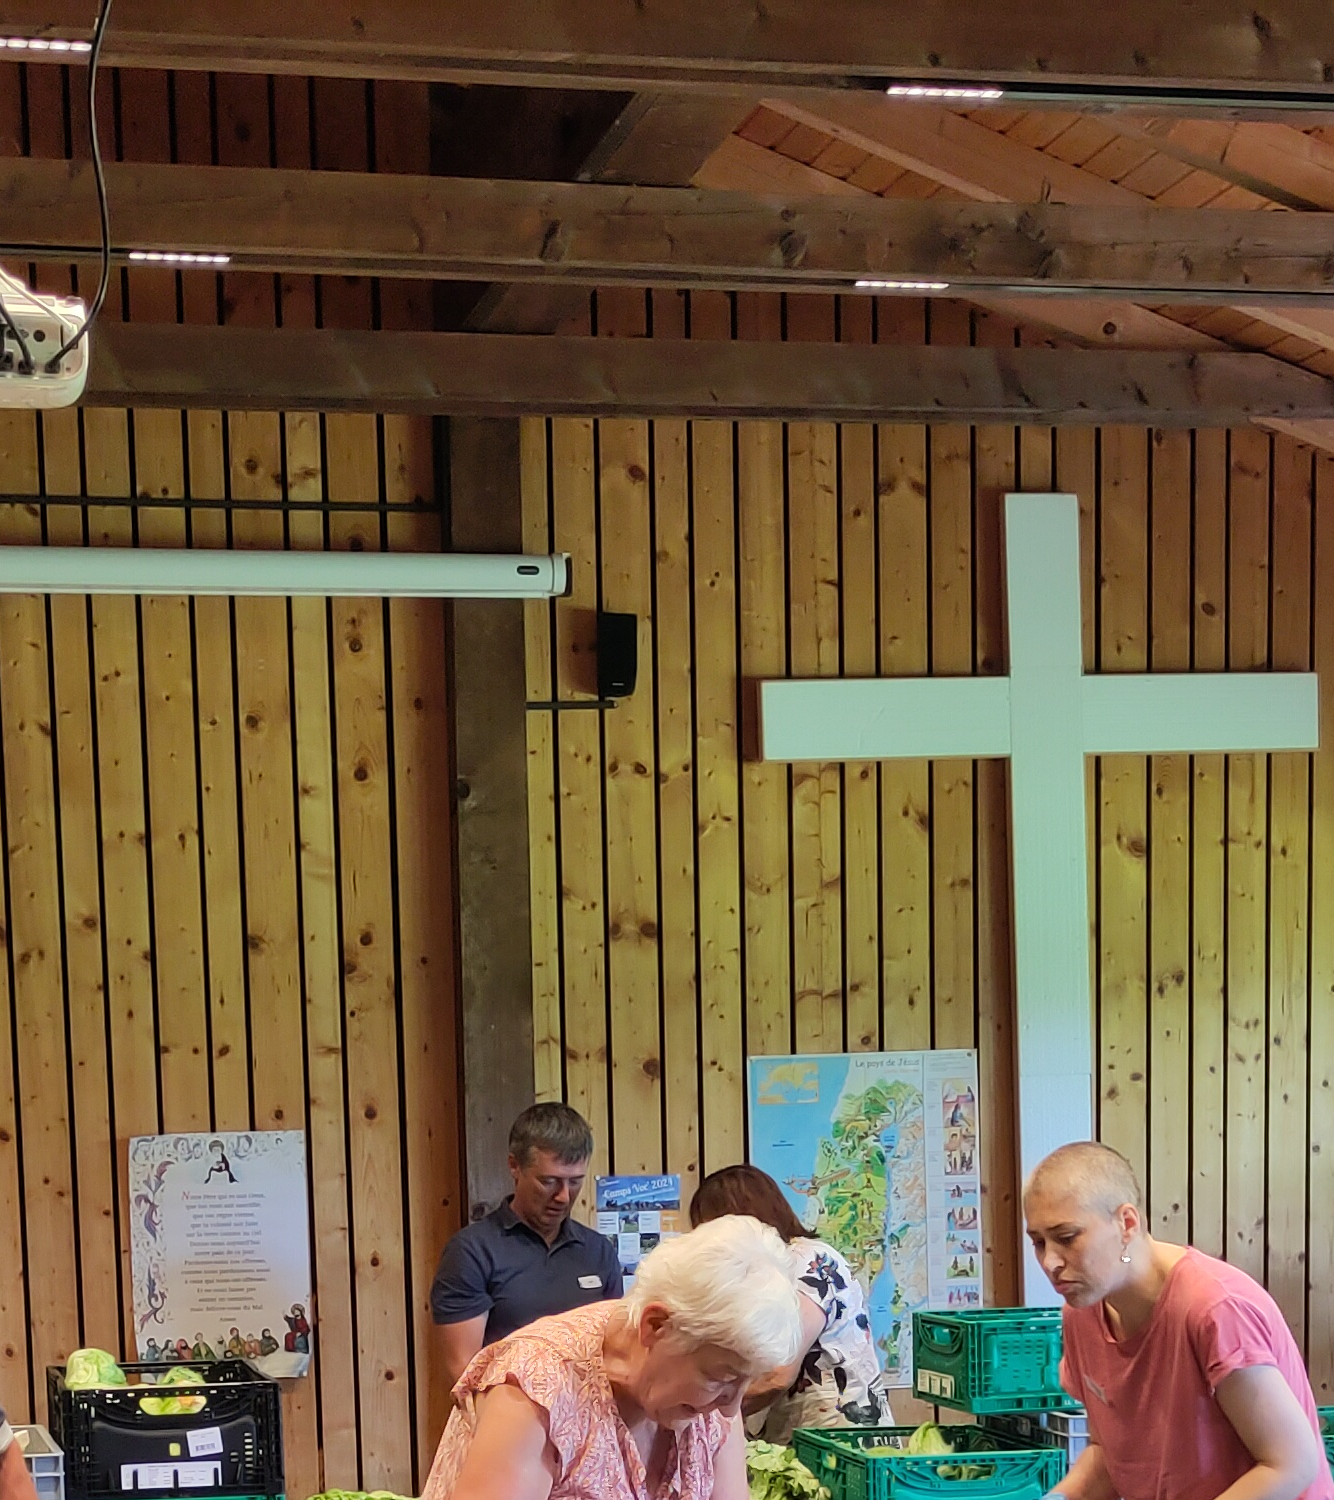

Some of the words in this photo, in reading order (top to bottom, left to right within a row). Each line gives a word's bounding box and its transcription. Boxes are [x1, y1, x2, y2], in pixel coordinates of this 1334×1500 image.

[855, 1059, 865, 1068] Le
[866, 1060, 884, 1069] pays
[886, 1058, 895, 1066] de
